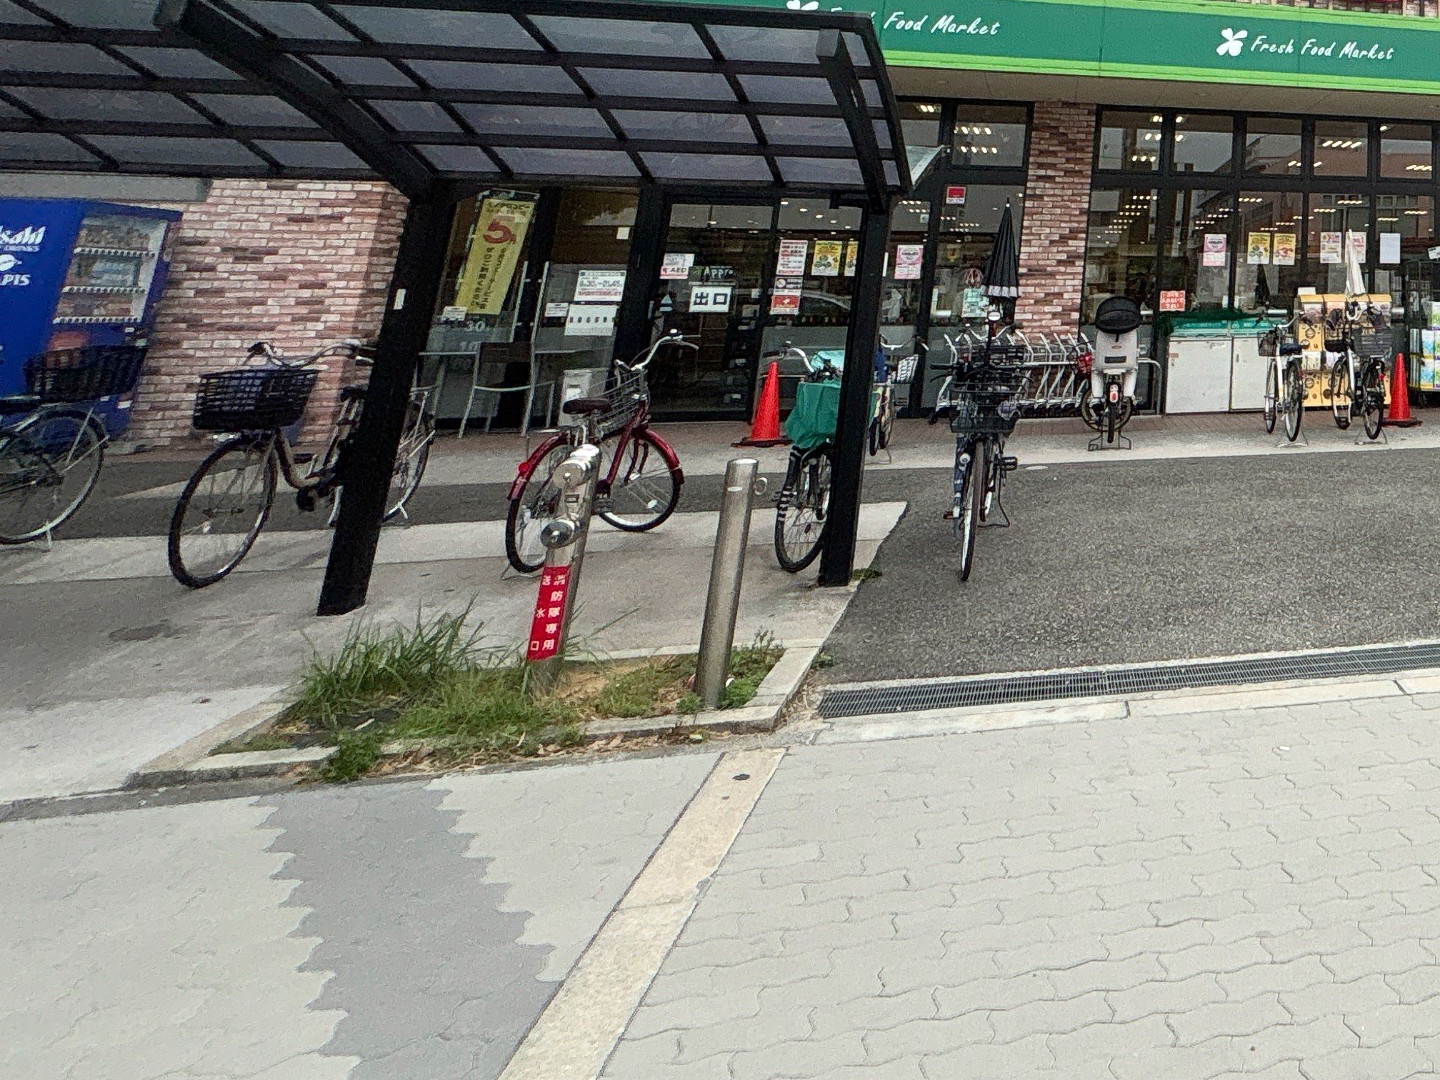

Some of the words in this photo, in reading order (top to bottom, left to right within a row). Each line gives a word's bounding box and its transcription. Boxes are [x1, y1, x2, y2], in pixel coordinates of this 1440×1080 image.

[884, 11, 928, 31] Food
[931, 14, 1000, 36] Market
[1251, 35, 1294, 54] Fresh
[1300, 38, 1336, 57] Food
[1339, 41, 1395, 60] Market
[0, 226, 46, 244] sahi
[694, 291, 728, 306] 出口
